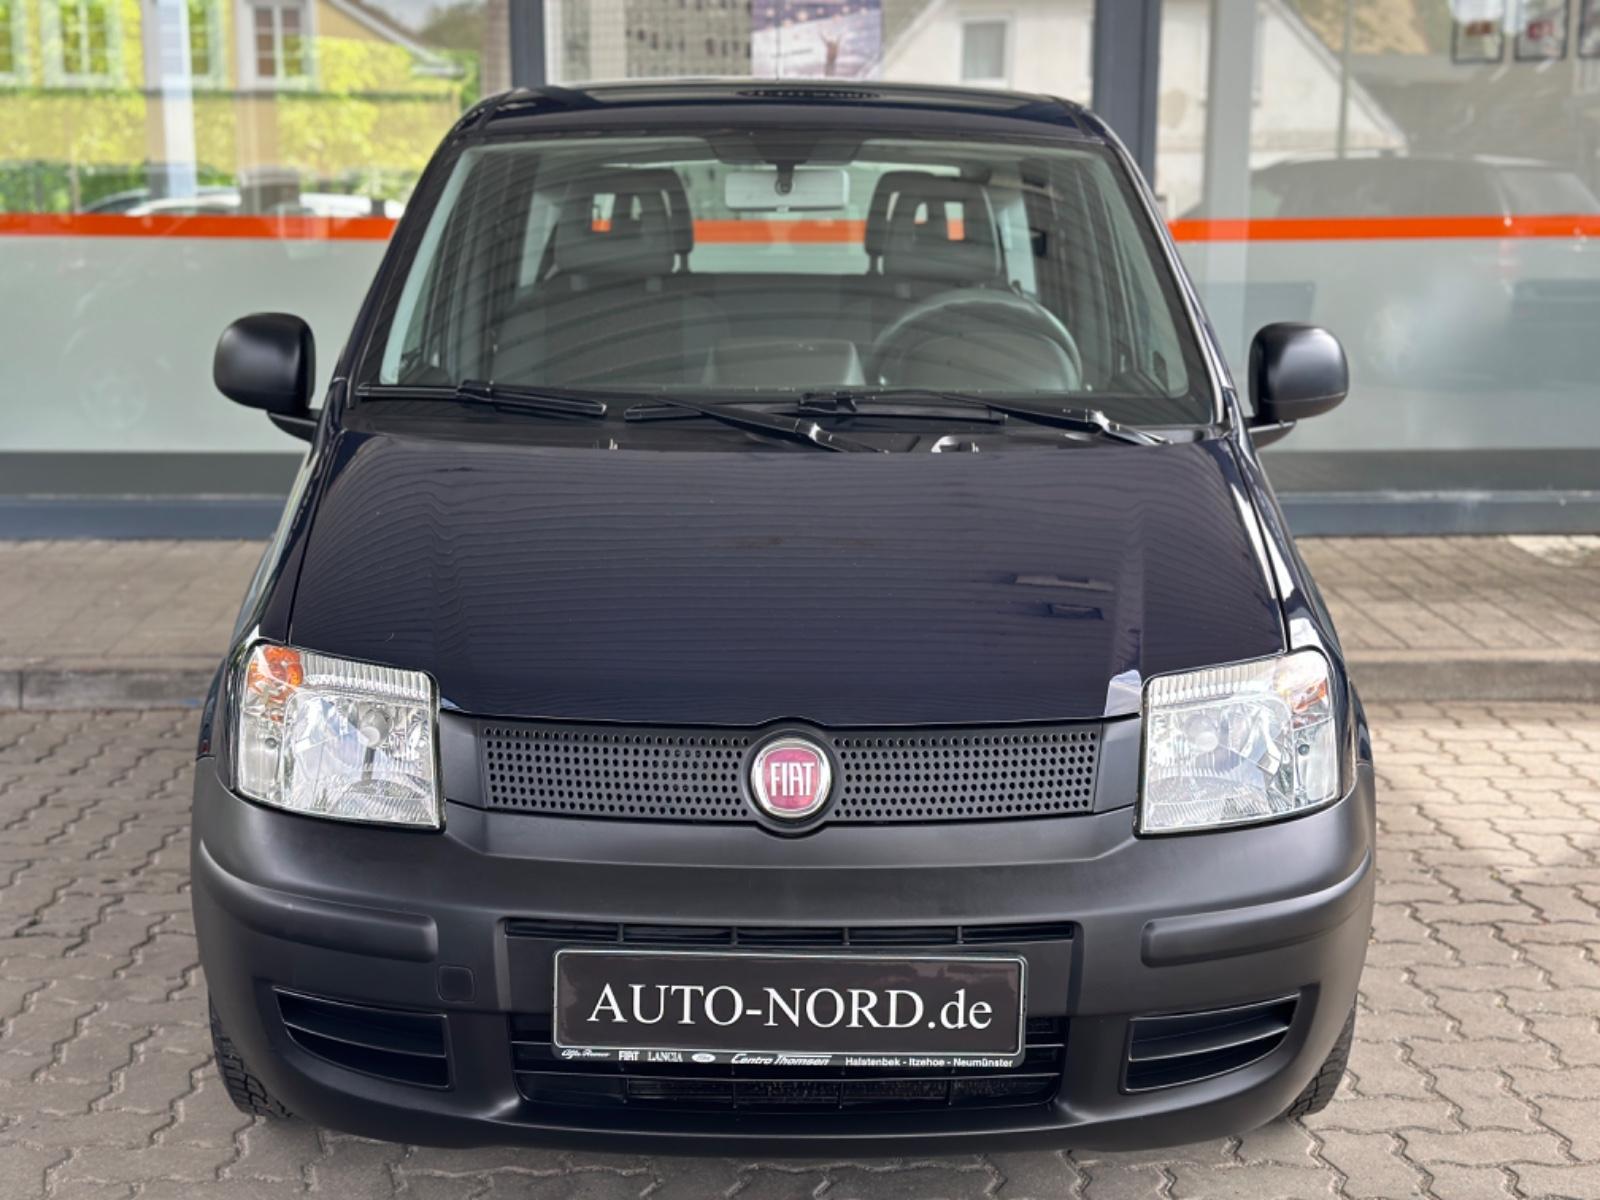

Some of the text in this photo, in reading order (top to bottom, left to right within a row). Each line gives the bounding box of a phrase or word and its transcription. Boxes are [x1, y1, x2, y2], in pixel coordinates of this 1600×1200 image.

[770, 762, 815, 797] FIAT
[586, 983, 993, 1030] AUTO-NORD.de
[618, 1050, 640, 1061] FIAT
[647, 1051, 684, 1063] LANCIA
[731, 1053, 832, 1066] Centro Thomsen
[845, 1057, 900, 1066] Halstenbek
[909, 1057, 945, 1067] Itzehoe
[953, 1057, 1013, 1068] Neumünster
